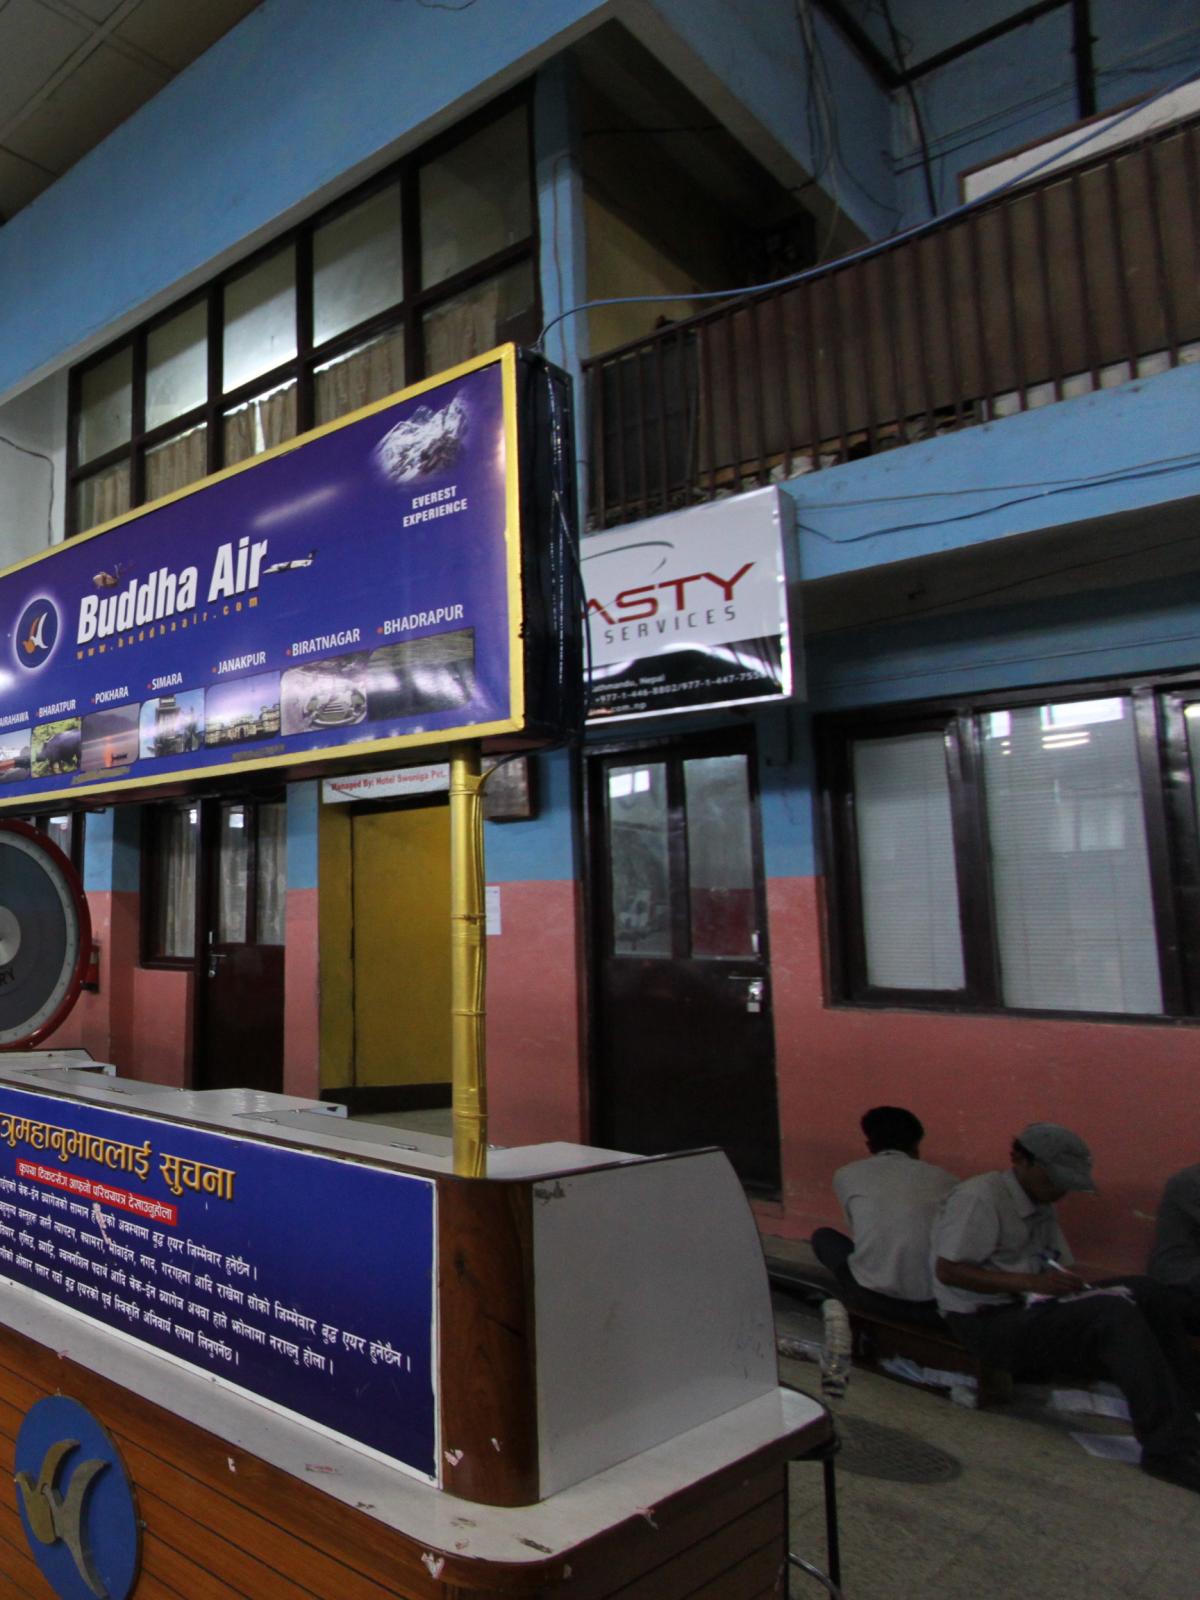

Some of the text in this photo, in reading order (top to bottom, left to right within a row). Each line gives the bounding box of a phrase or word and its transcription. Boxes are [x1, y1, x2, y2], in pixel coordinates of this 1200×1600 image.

[412, 485, 457, 509] EVEREST
[403, 498, 468, 527] EXPERIENCE
[77, 535, 268, 645] Buddha Air
[581, 561, 756, 625] ASTY
[383, 604, 464, 636] BHADRAPUR
[604, 605, 736, 645] SERVICES
[291, 628, 361, 657] BIRATNAGAR
[217, 651, 267, 674] JANAKPUR
[95, 686, 129, 705] POKHARA
[151, 672, 183, 691] SIMARA
[38, 699, 76, 718] BHARATPUR
[159, 1152, 236, 1201] सुचना
[167, 1236, 184, 1255] एयर
[187, 1239, 222, 1268] जिम्मेवार
[77, 1281, 99, 1301] एयरको
[110, 1268, 127, 1287] आदि
[187, 1301, 210, 1321] अथवा
[212, 1311, 228, 1330] हाते
[302, 1345, 326, 1371] होला
[194, 1273, 213, 1294] आदि
[216, 1283, 244, 1305] राखेमा
[247, 1292, 271, 1316] सोको
[274, 1300, 317, 1336] जिम्मेवार
[342, 1331, 366, 1354] एयर
